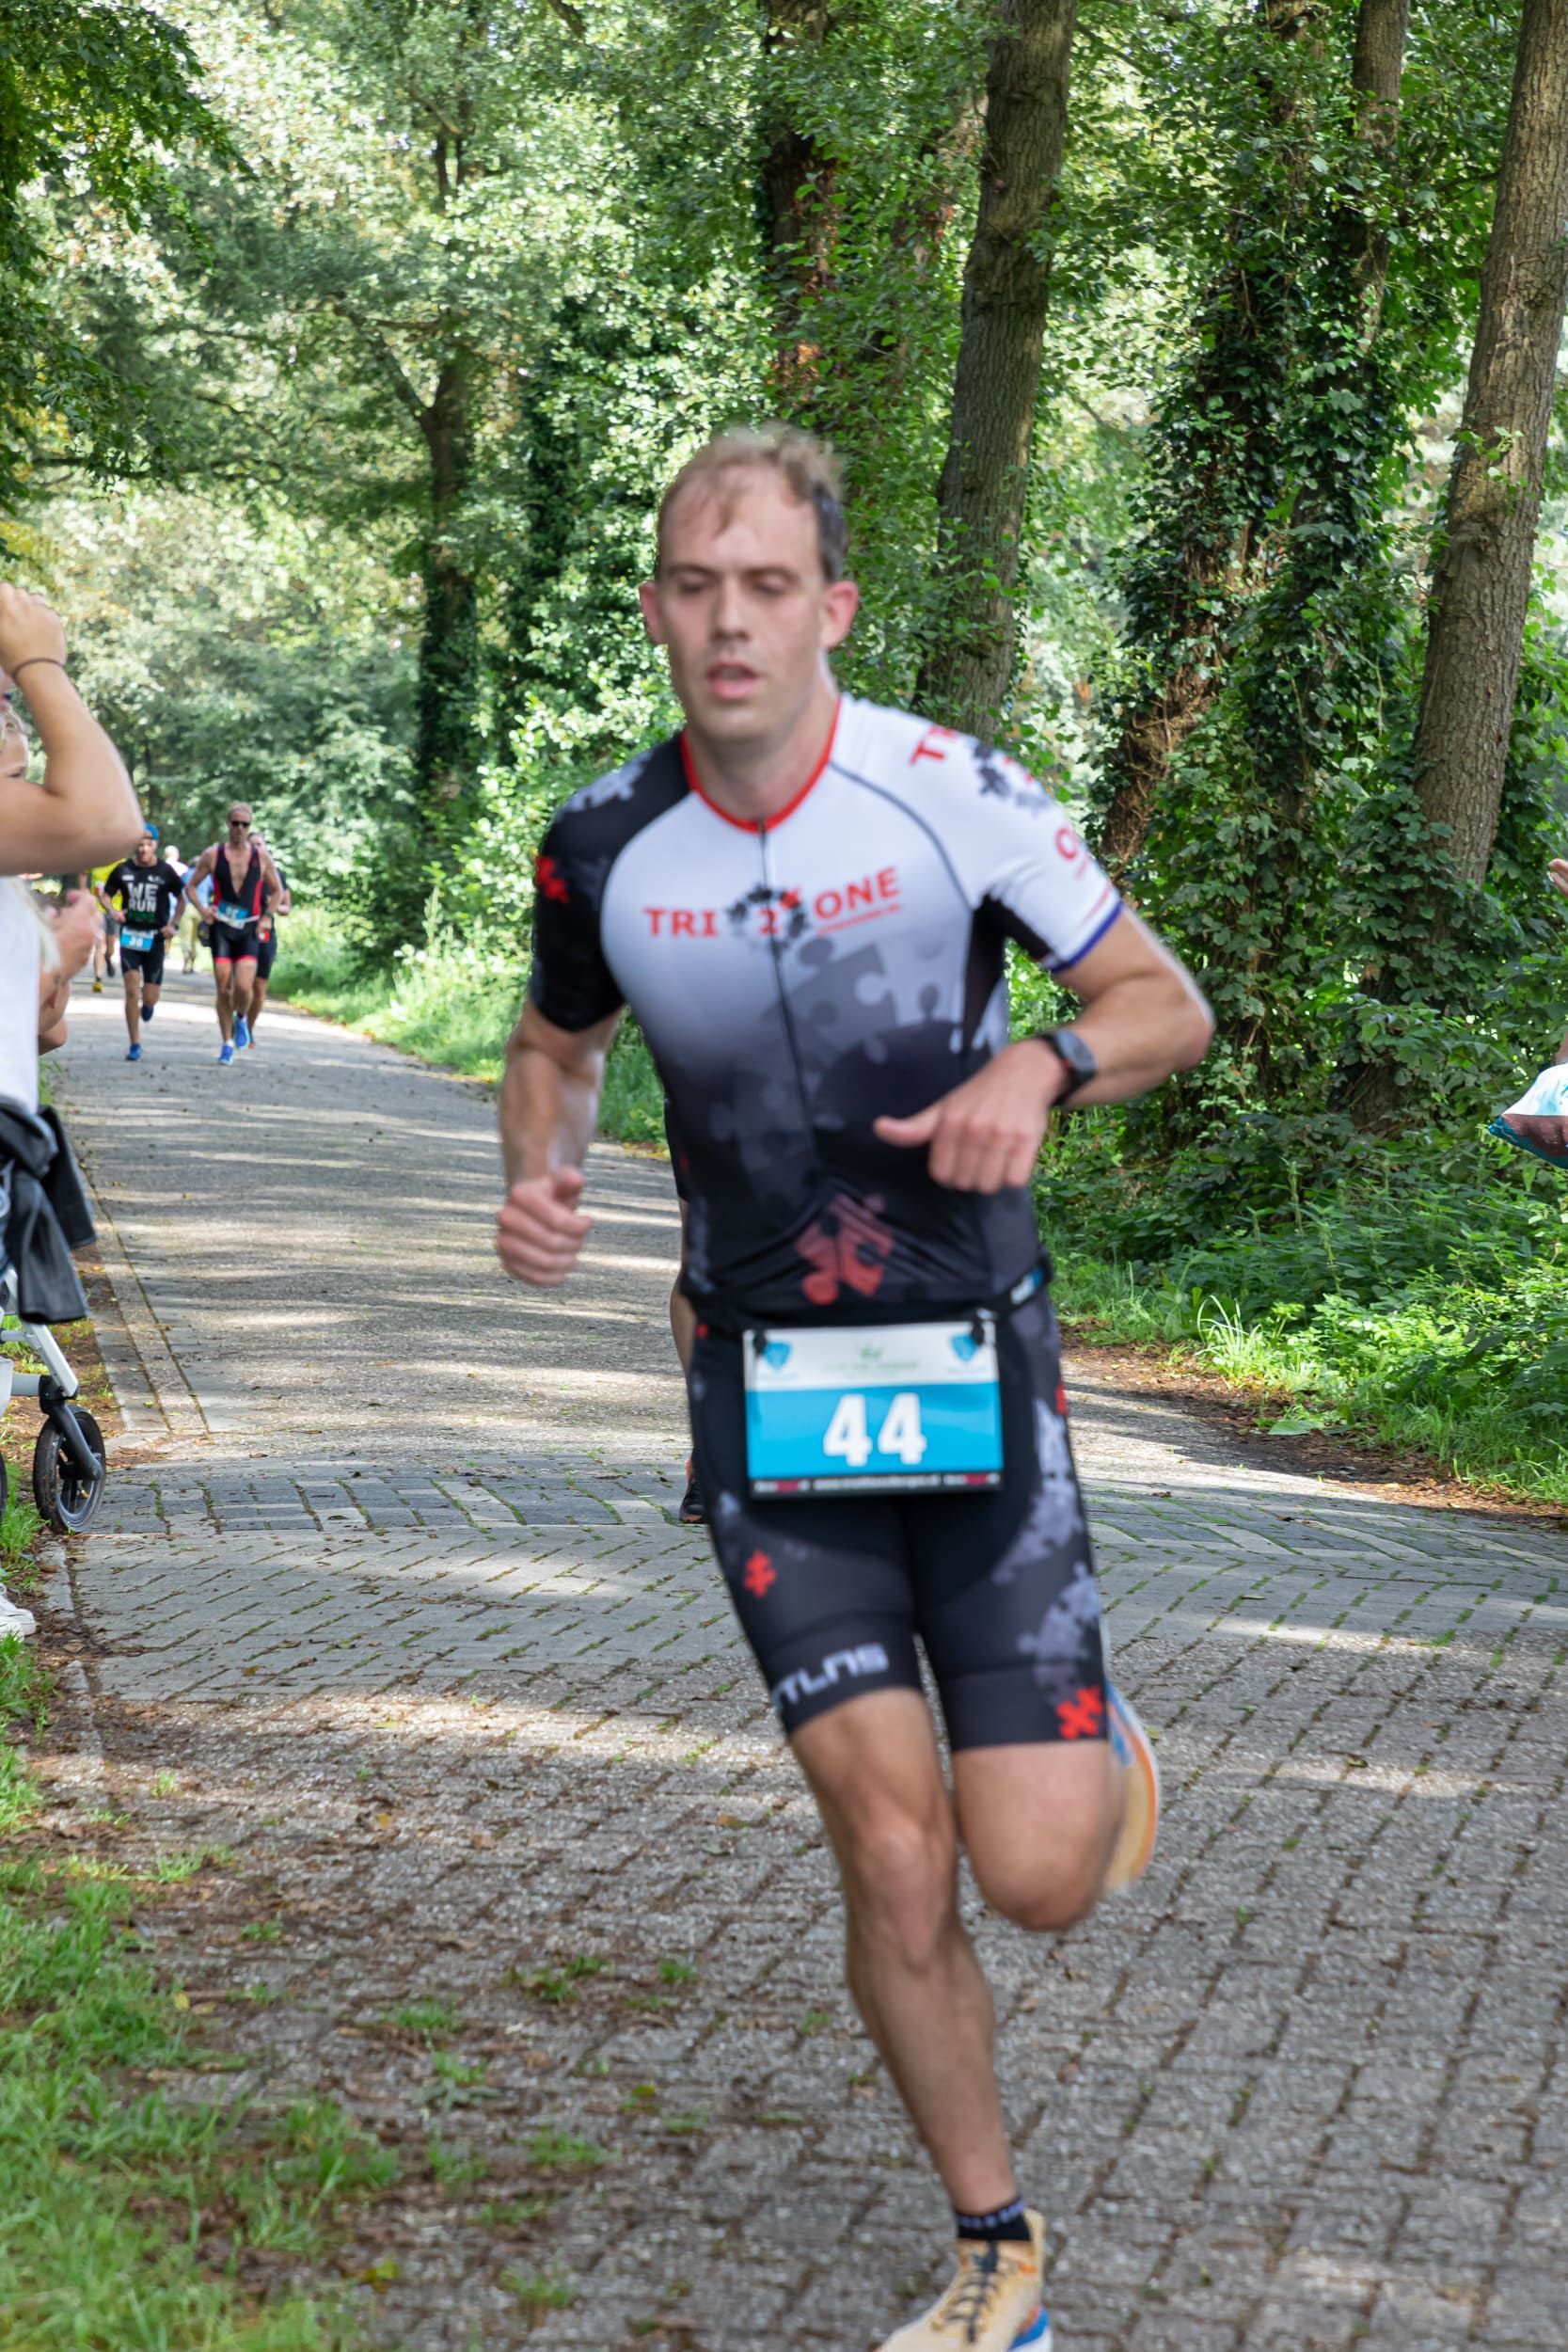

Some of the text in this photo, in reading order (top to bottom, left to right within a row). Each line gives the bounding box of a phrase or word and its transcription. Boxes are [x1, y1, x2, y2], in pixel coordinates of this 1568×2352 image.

[127, 882, 159, 900] WE
[128, 898, 157, 913] RUN
[642, 906, 719, 938] TRI
[814, 865, 899, 920] ONE
[822, 1392, 927, 1468] 44
